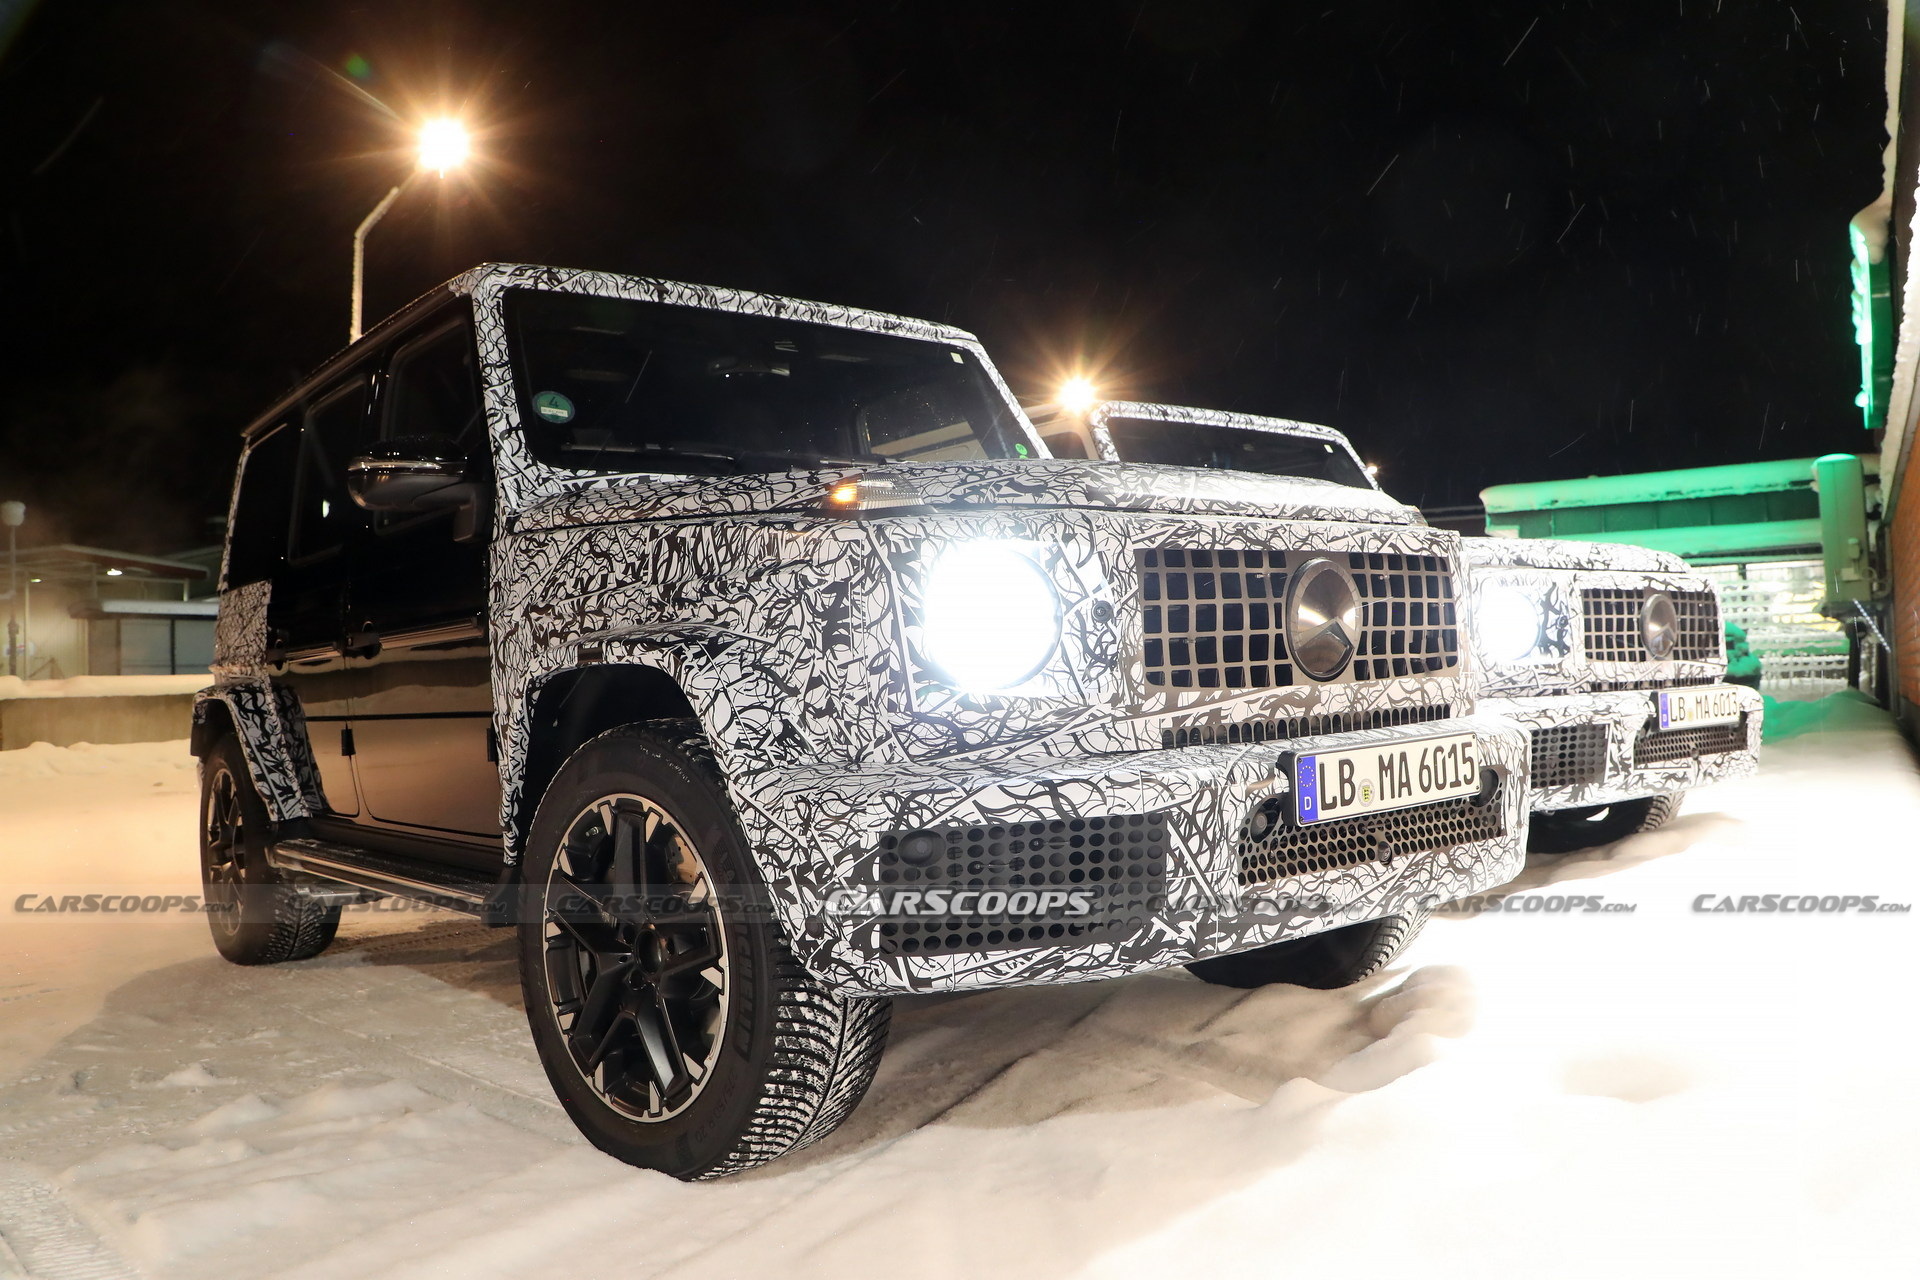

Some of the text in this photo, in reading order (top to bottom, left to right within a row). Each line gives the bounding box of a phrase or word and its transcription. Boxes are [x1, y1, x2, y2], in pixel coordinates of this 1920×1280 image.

[549, 396, 559, 408] 4
[1669, 697, 1686, 722] LB
[1695, 694, 1711, 719] MA
[1319, 742, 1475, 811] LB MA 6015
[1304, 796, 1313, 810] D
[734, 905, 756, 1056] ICHELIN
